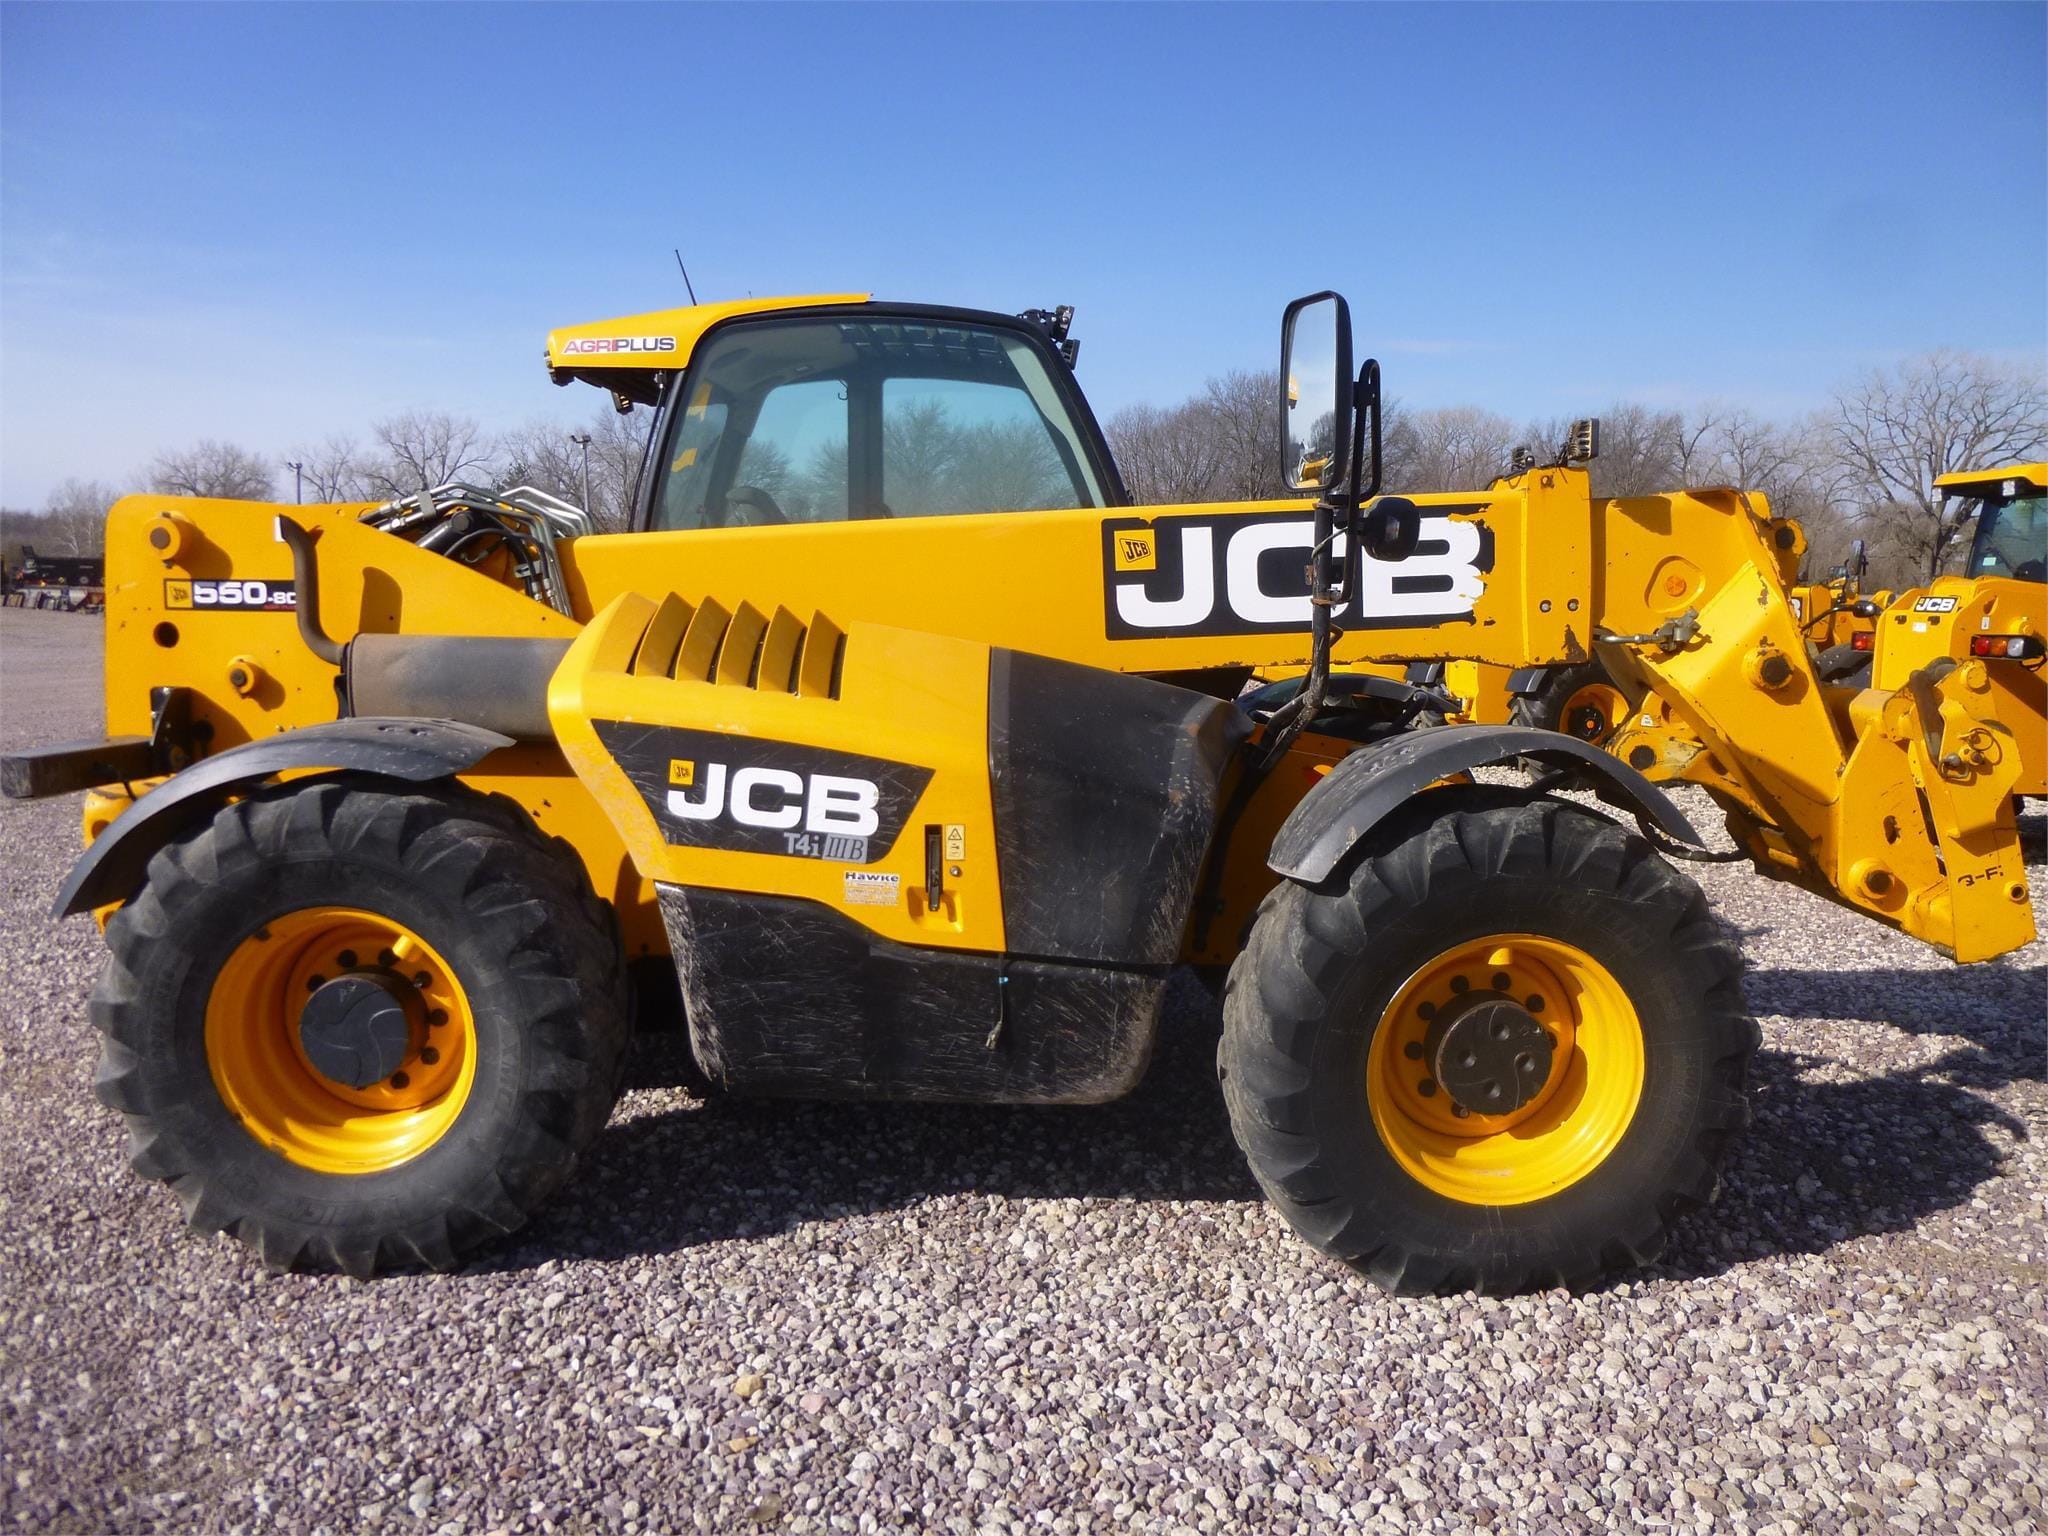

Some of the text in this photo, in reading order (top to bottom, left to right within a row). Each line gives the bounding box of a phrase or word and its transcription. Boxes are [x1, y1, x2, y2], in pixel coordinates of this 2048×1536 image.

[564, 337, 675, 353] AGRIPLUS
[1125, 541, 1149, 560] JCB
[1115, 517, 1484, 628] JCB
[1915, 598, 1956, 612] JCB
[667, 763, 879, 837] JCB
[784, 832, 822, 857] T4i
[845, 871, 899, 882] Hawke
